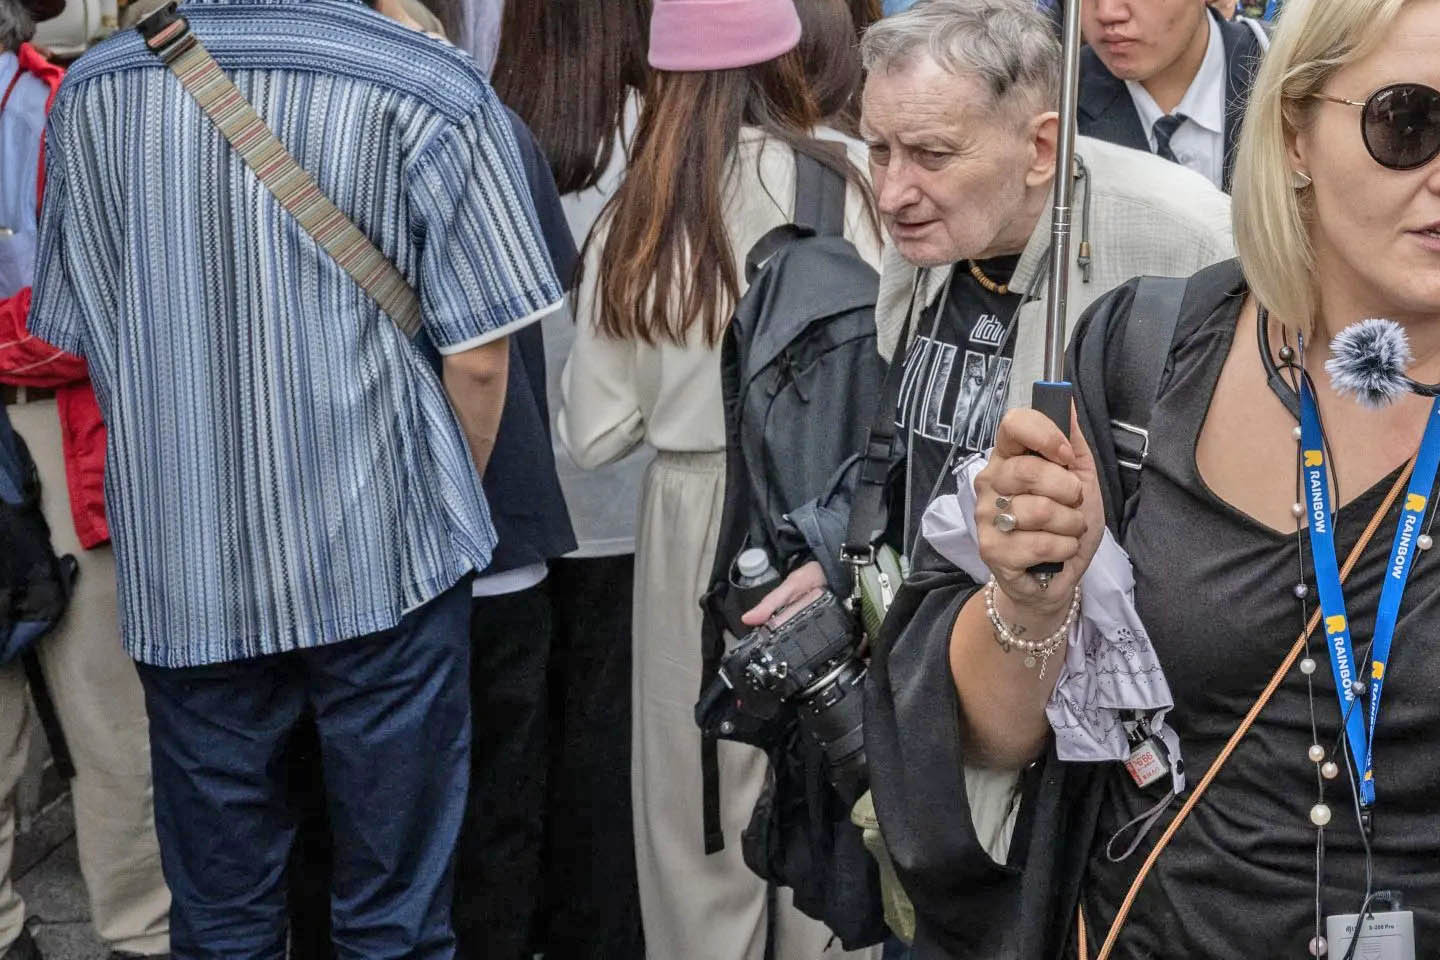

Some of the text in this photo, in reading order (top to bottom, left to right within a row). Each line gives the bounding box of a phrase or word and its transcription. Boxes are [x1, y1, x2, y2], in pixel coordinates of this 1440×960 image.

[1310, 470, 1326, 534] RAINBOW
[1391, 514, 1417, 580] RAINBOW
[1333, 636, 1355, 702] RAINBOW
